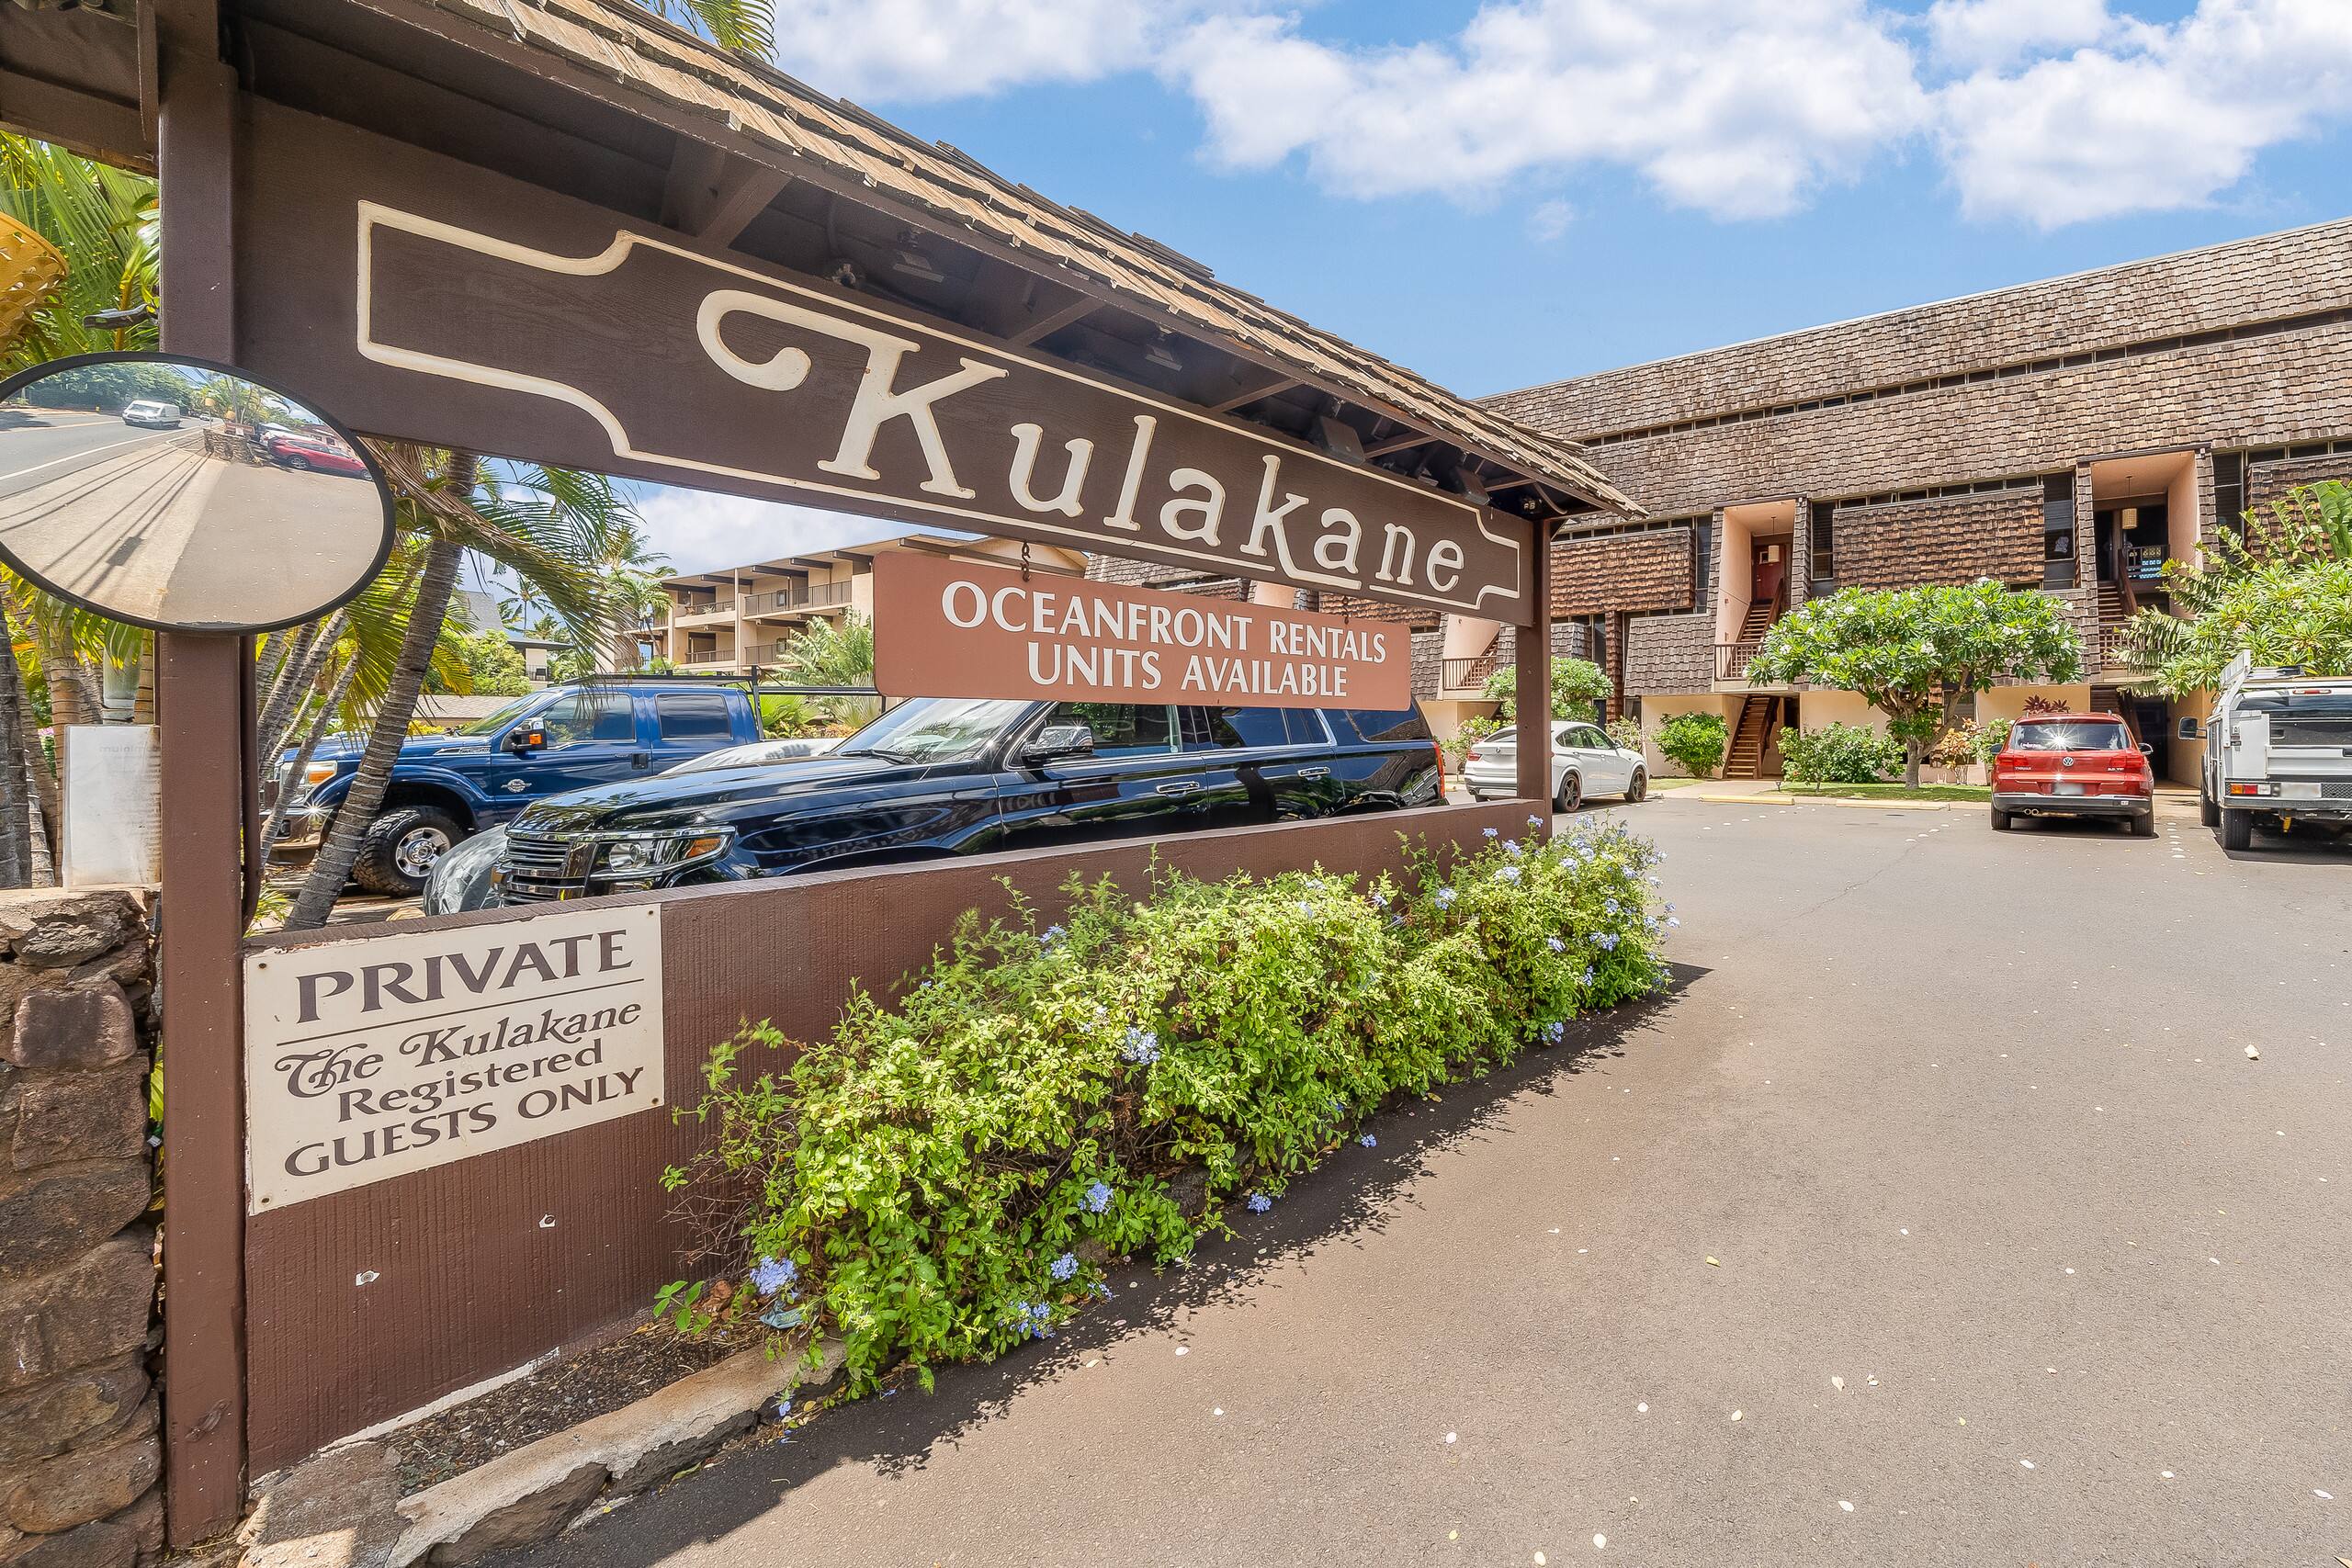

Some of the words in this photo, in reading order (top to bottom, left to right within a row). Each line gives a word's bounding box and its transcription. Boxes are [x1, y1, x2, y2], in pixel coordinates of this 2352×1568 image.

[695, 289, 1465, 592] Kulakane
[941, 581, 1251, 652] OCEANFRONT
[1269, 619, 1385, 663] RENTALS
[1027, 642, 1161, 691] UNITS
[1181, 654, 1347, 697] AVAILABLE
[296, 930, 634, 1024] PRIVATE
[274, 1043, 384, 1099] The
[399, 1003, 641, 1067] Kulakane
[337, 1038, 603, 1123] Registered
[284, 1101, 497, 1177] GUESTS
[518, 1066, 644, 1119] ONLY
